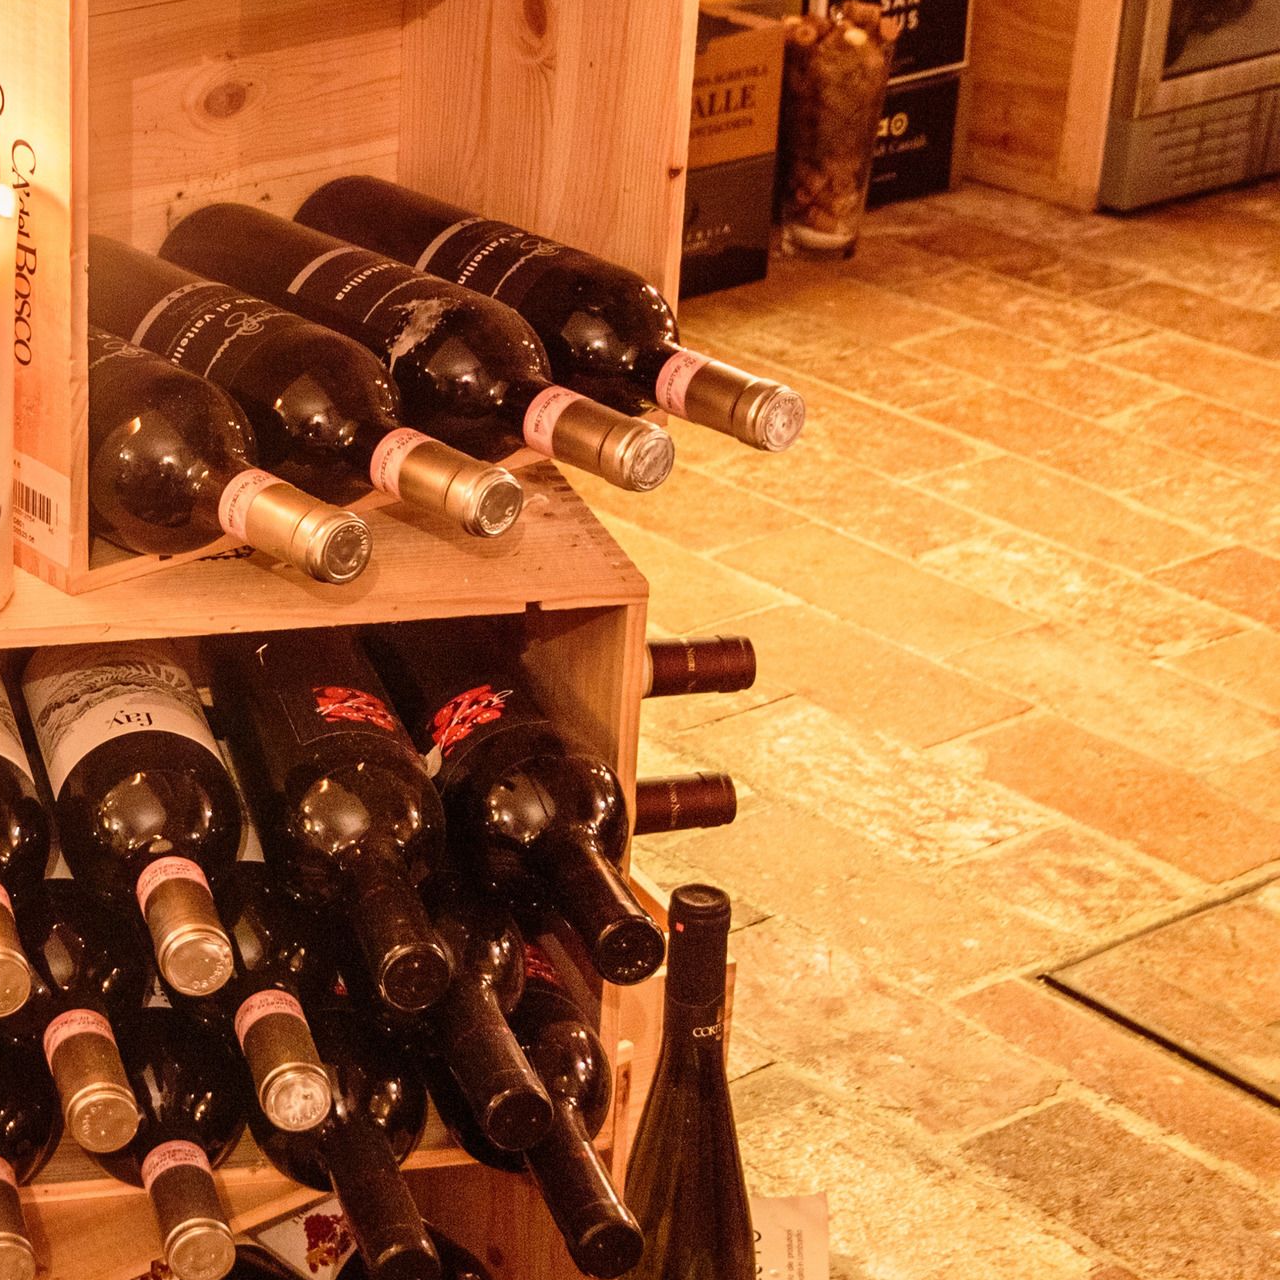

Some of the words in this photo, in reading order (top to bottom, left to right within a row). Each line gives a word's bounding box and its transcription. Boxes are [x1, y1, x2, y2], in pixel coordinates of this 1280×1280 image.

[692, 84, 757, 119] ALLE
[457, 237, 510, 285] Valtellin
[170, 312, 217, 364] Valtelli
[105, 709, 154, 730] fay
